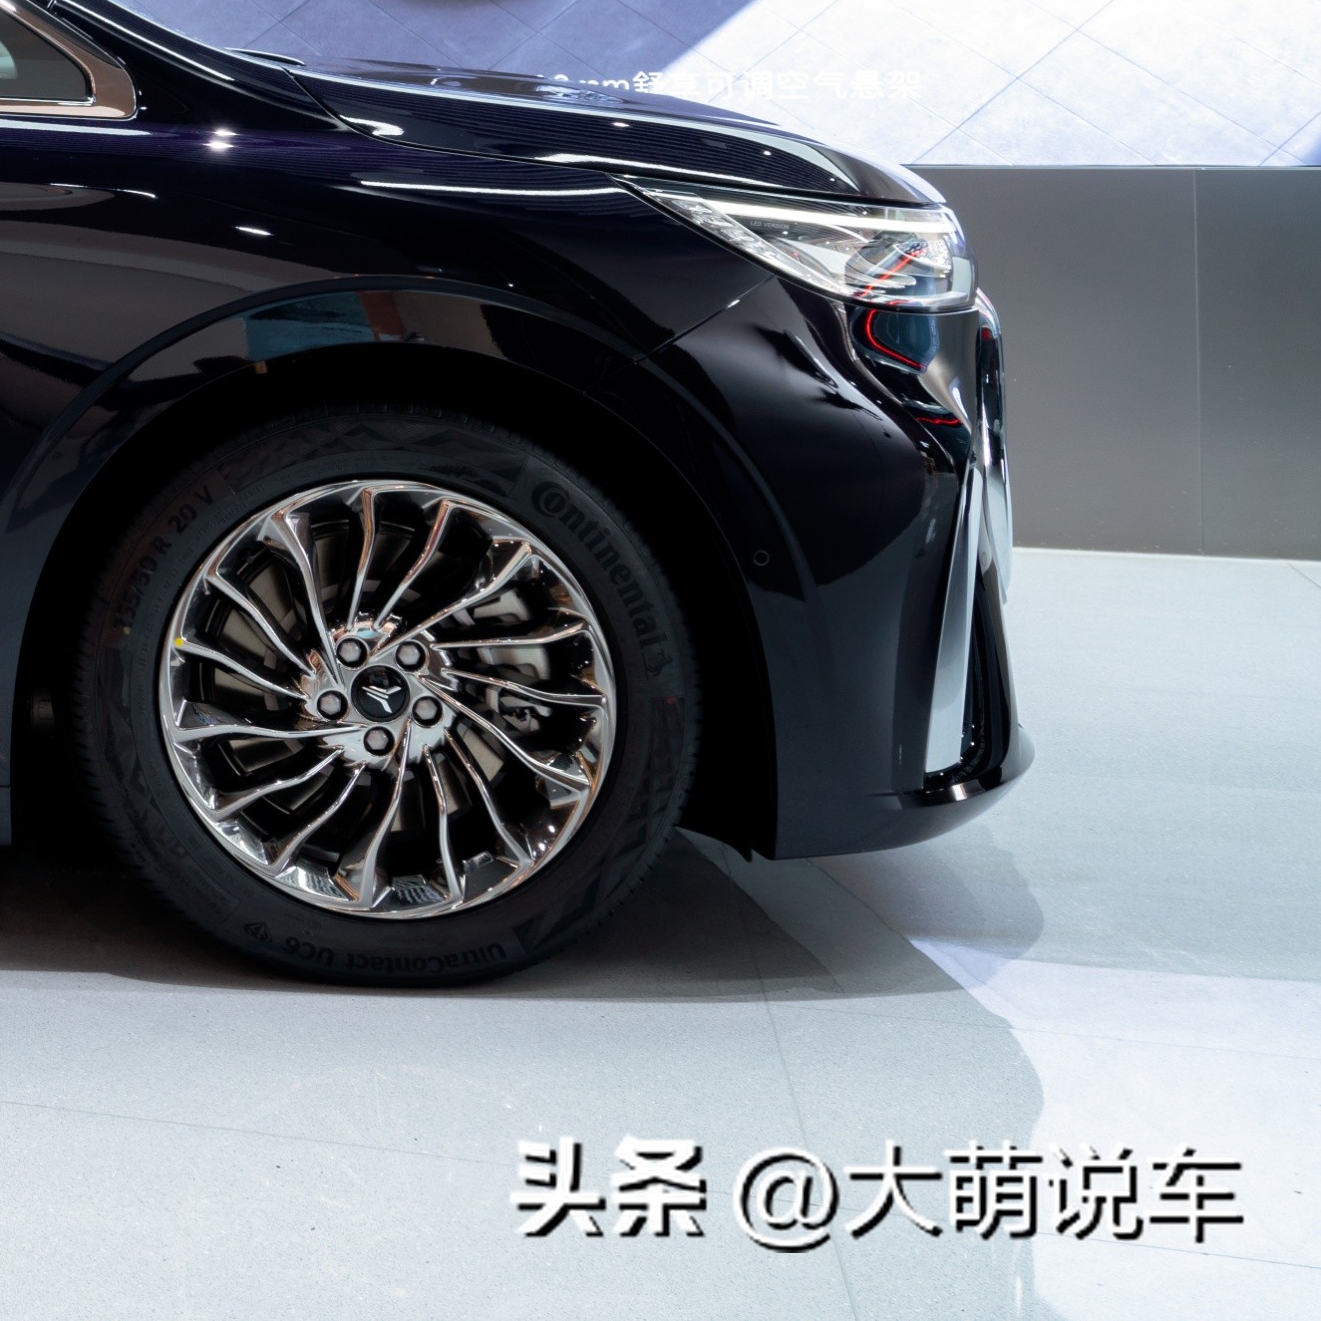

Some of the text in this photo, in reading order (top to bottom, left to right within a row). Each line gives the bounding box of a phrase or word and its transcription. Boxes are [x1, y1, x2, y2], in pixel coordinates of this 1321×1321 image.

[763, 221, 790, 230] VERSION
[168, 503, 197, 534] 20
[531, 480, 669, 649] Continental
[283, 936, 507, 974] UltraContact UC6
